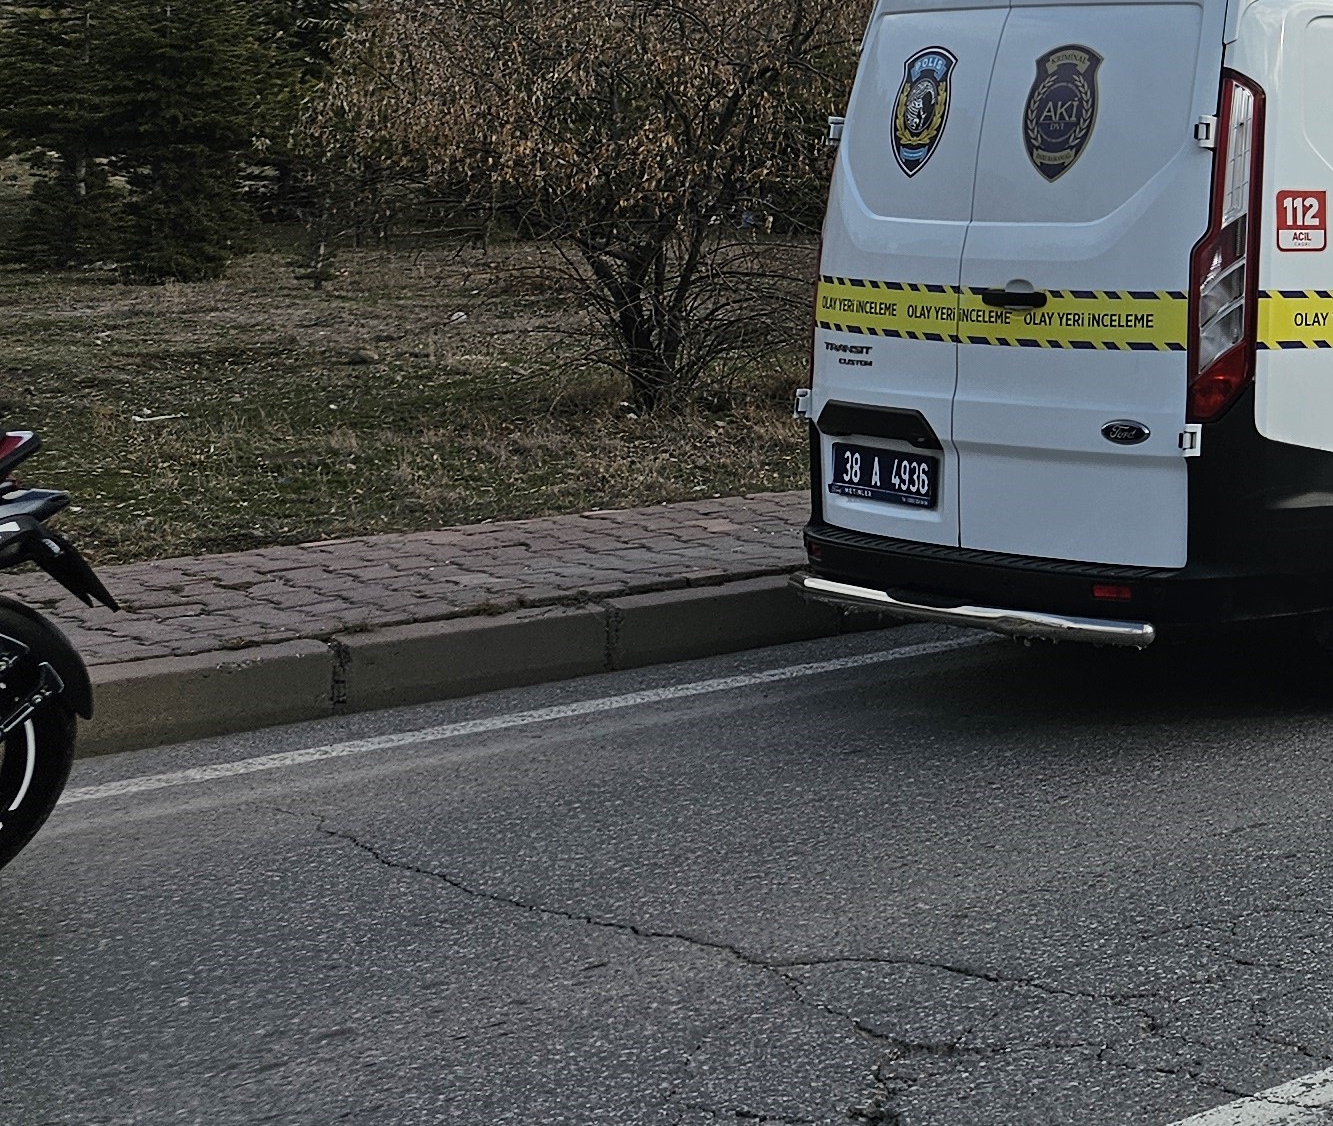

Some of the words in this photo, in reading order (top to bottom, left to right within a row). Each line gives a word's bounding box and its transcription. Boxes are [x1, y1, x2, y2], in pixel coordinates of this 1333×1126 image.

[1283, 197, 1319, 226] 112
[822, 295, 837, 309] OLAY
[907, 304, 932, 319] OLAY
[1023, 312, 1055, 326] OLAY
[1294, 312, 1329, 327] OLAY
[823, 341, 873, 355] TRANSIT
[838, 357, 873, 367] CUSTOM
[1110, 424, 1137, 439] Ford
[842, 450, 860, 483] 38
[871, 456, 880, 487] A
[891, 458, 929, 494] 4936
